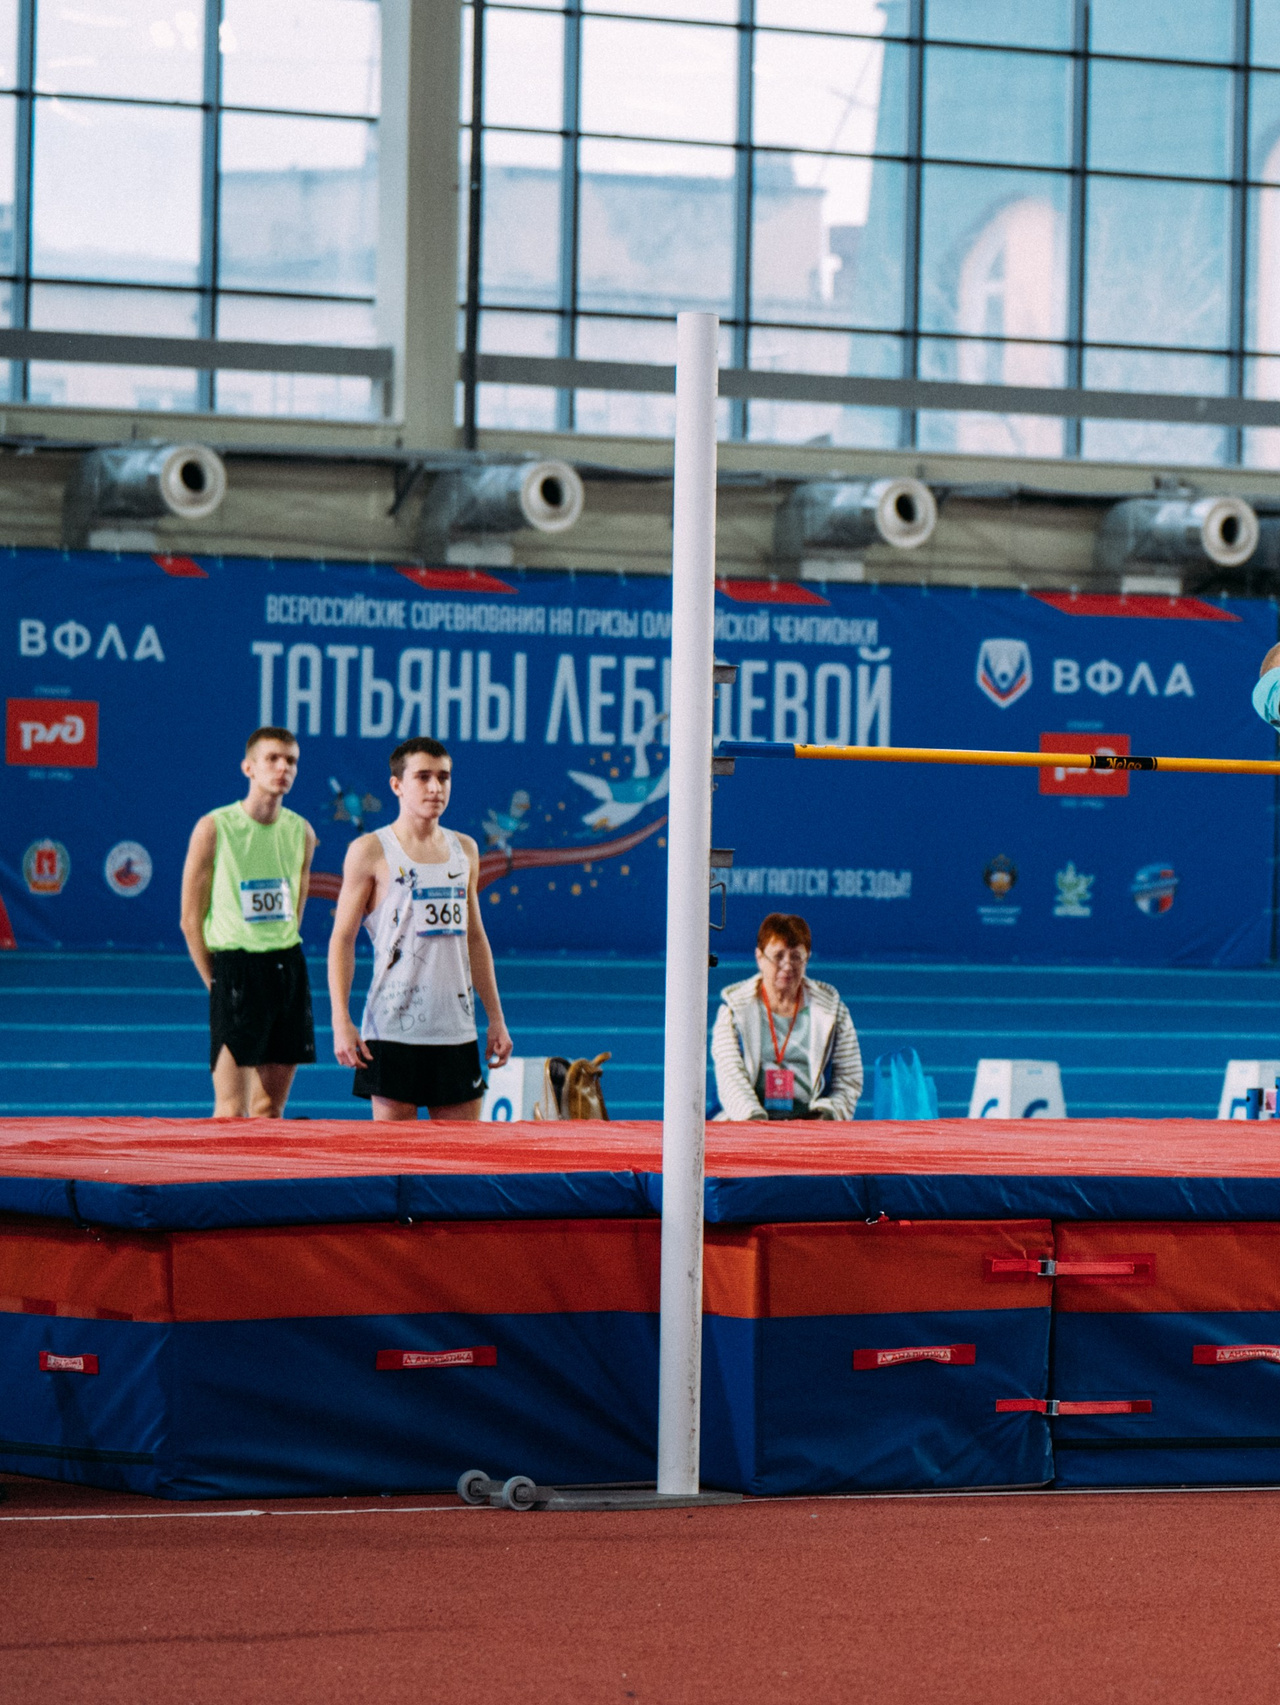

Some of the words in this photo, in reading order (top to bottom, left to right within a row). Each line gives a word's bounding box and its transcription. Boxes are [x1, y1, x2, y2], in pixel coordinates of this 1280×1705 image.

[19, 619, 165, 662] ВФЛА
[266, 594, 406, 629] ВСЕРОССИЙСКИЕ
[411, 601, 545, 635] СОРЕВНОВАНИЯ
[549, 607, 573, 636] НА
[577, 608, 638, 638] ПРИЗЫ
[773, 615, 879, 646] ЧЕМПИОНКИ
[251, 641, 528, 742] ТАТЬЯНЫ
[1051, 658, 1195, 698] ВФЛА
[425, 903, 461, 925] 368
